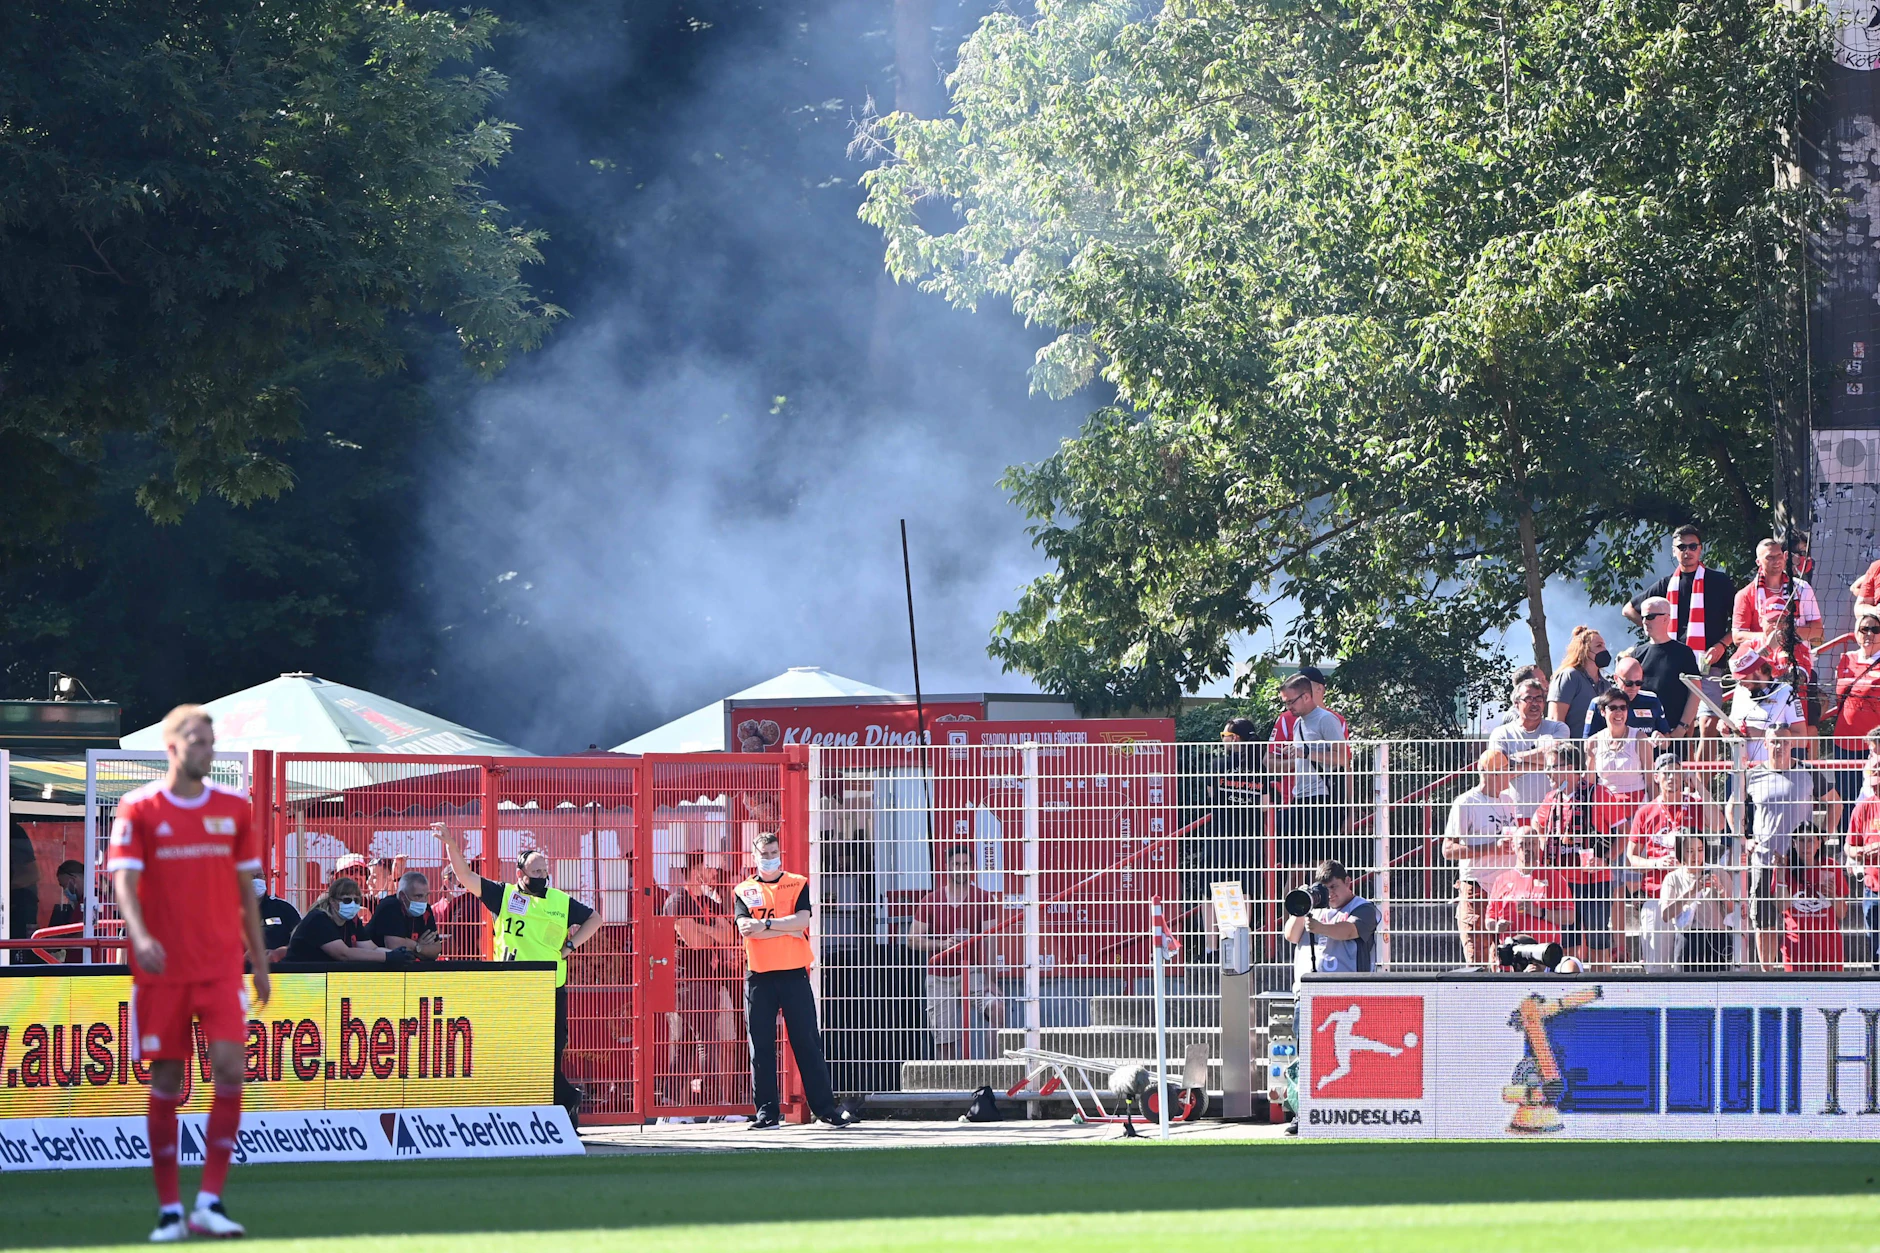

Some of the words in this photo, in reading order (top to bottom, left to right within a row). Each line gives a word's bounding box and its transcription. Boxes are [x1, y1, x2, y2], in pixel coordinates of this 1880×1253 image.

[1846, 52, 1880, 68] Köp
[783, 726, 859, 746] Kleene
[981, 733, 1007, 745] STADION
[1009, 733, 1018, 745] AN
[1034, 732, 1052, 745] ALTEN
[1054, 730, 1087, 745] FÖRSTEREI
[504, 917, 525, 937] 12
[1309, 1109, 1422, 1125] BUNDESLIGA
[194, 1118, 368, 1163] Igenieurbüro
[411, 1111, 564, 1149] ibr-berlin.de
